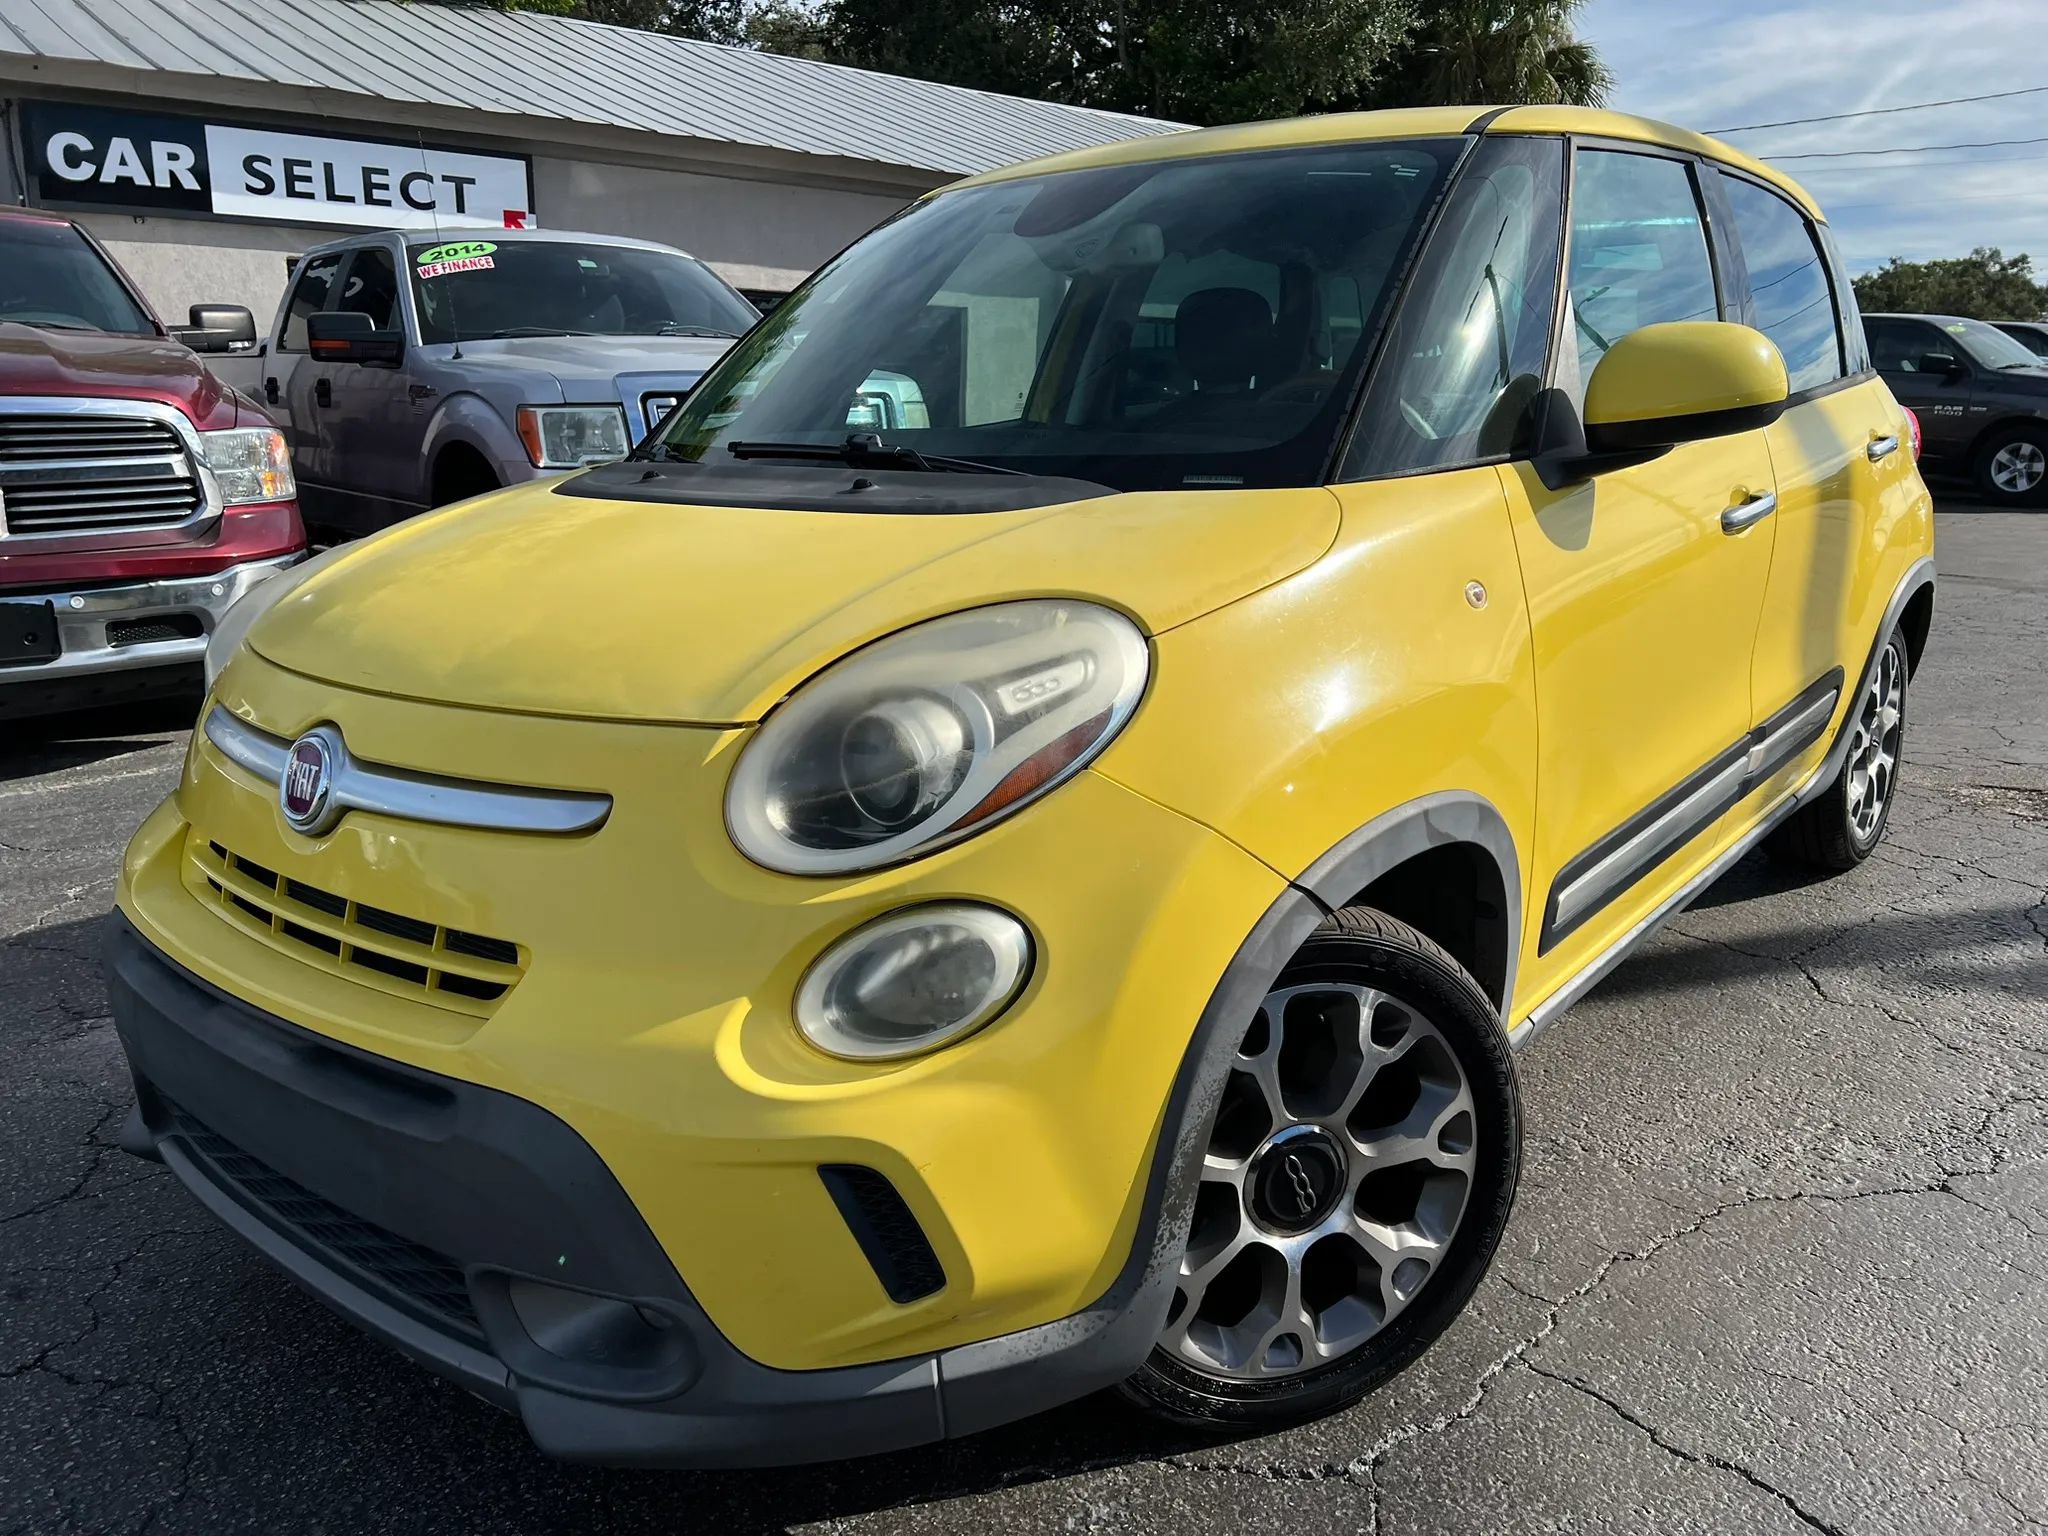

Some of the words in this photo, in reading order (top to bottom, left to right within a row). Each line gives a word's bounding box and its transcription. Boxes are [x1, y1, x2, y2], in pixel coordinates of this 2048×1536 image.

[46, 131, 201, 190] CAR
[242, 154, 476, 214] SELECT
[420, 264, 439, 278] WE
[441, 257, 492, 273] FINANCE
[429, 243, 487, 261] 2014
[288, 759, 320, 801] FIAT
